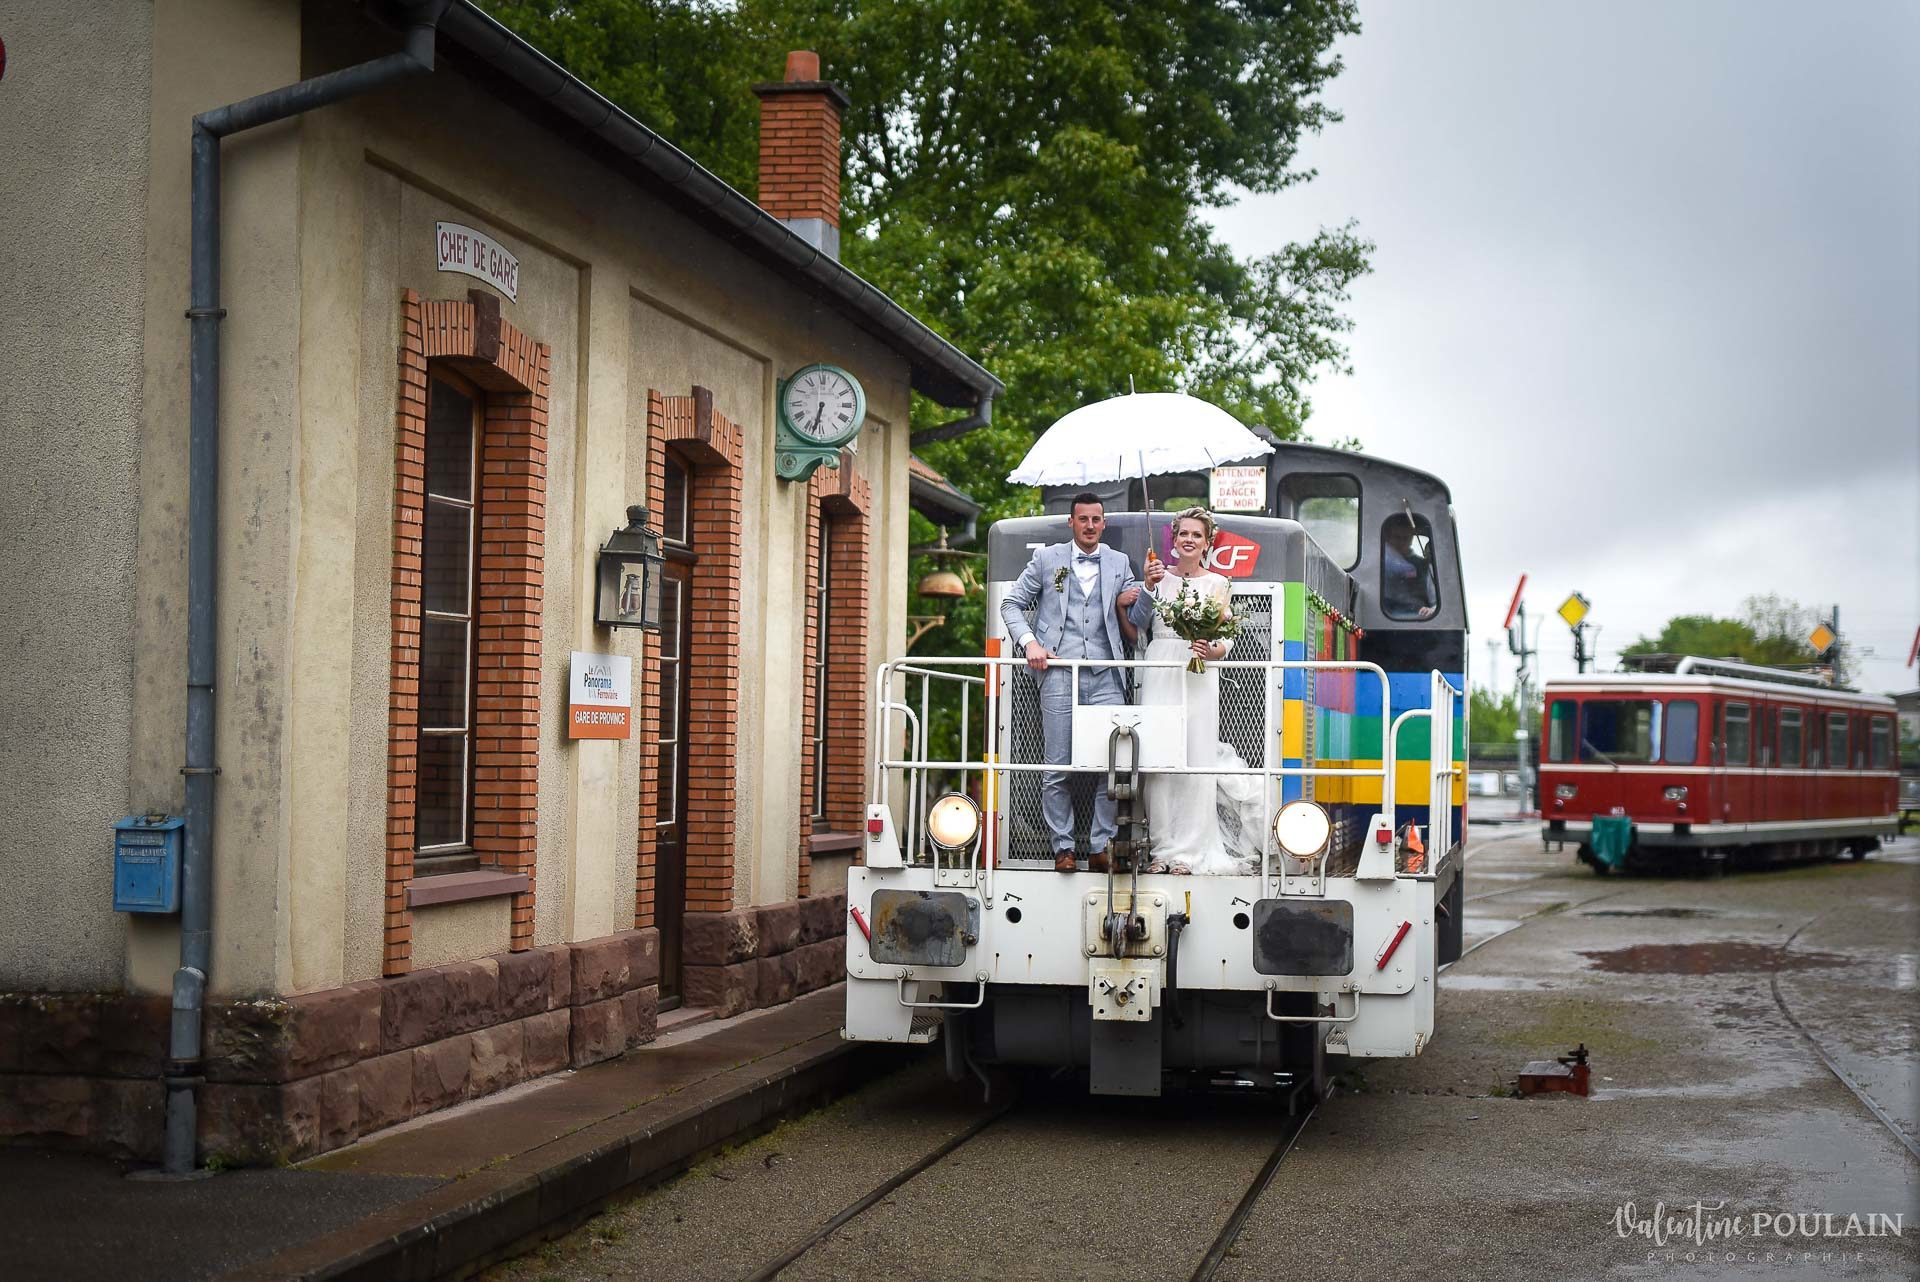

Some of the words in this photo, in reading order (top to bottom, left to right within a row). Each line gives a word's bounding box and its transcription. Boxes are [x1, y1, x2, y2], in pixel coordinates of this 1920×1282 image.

[440, 231, 469, 265] CHEF
[473, 239, 487, 272] DE
[490, 248, 516, 293] GARE
[1216, 467, 1262, 478] ATTENTION
[1219, 487, 1256, 497] DANGER
[1216, 498, 1229, 508] DE
[1233, 498, 1259, 508] MORT
[583, 673, 612, 689] Panorama
[575, 711, 590, 724] GARE
[591, 711, 599, 724] DE
[599, 711, 626, 725] PROVINCE
